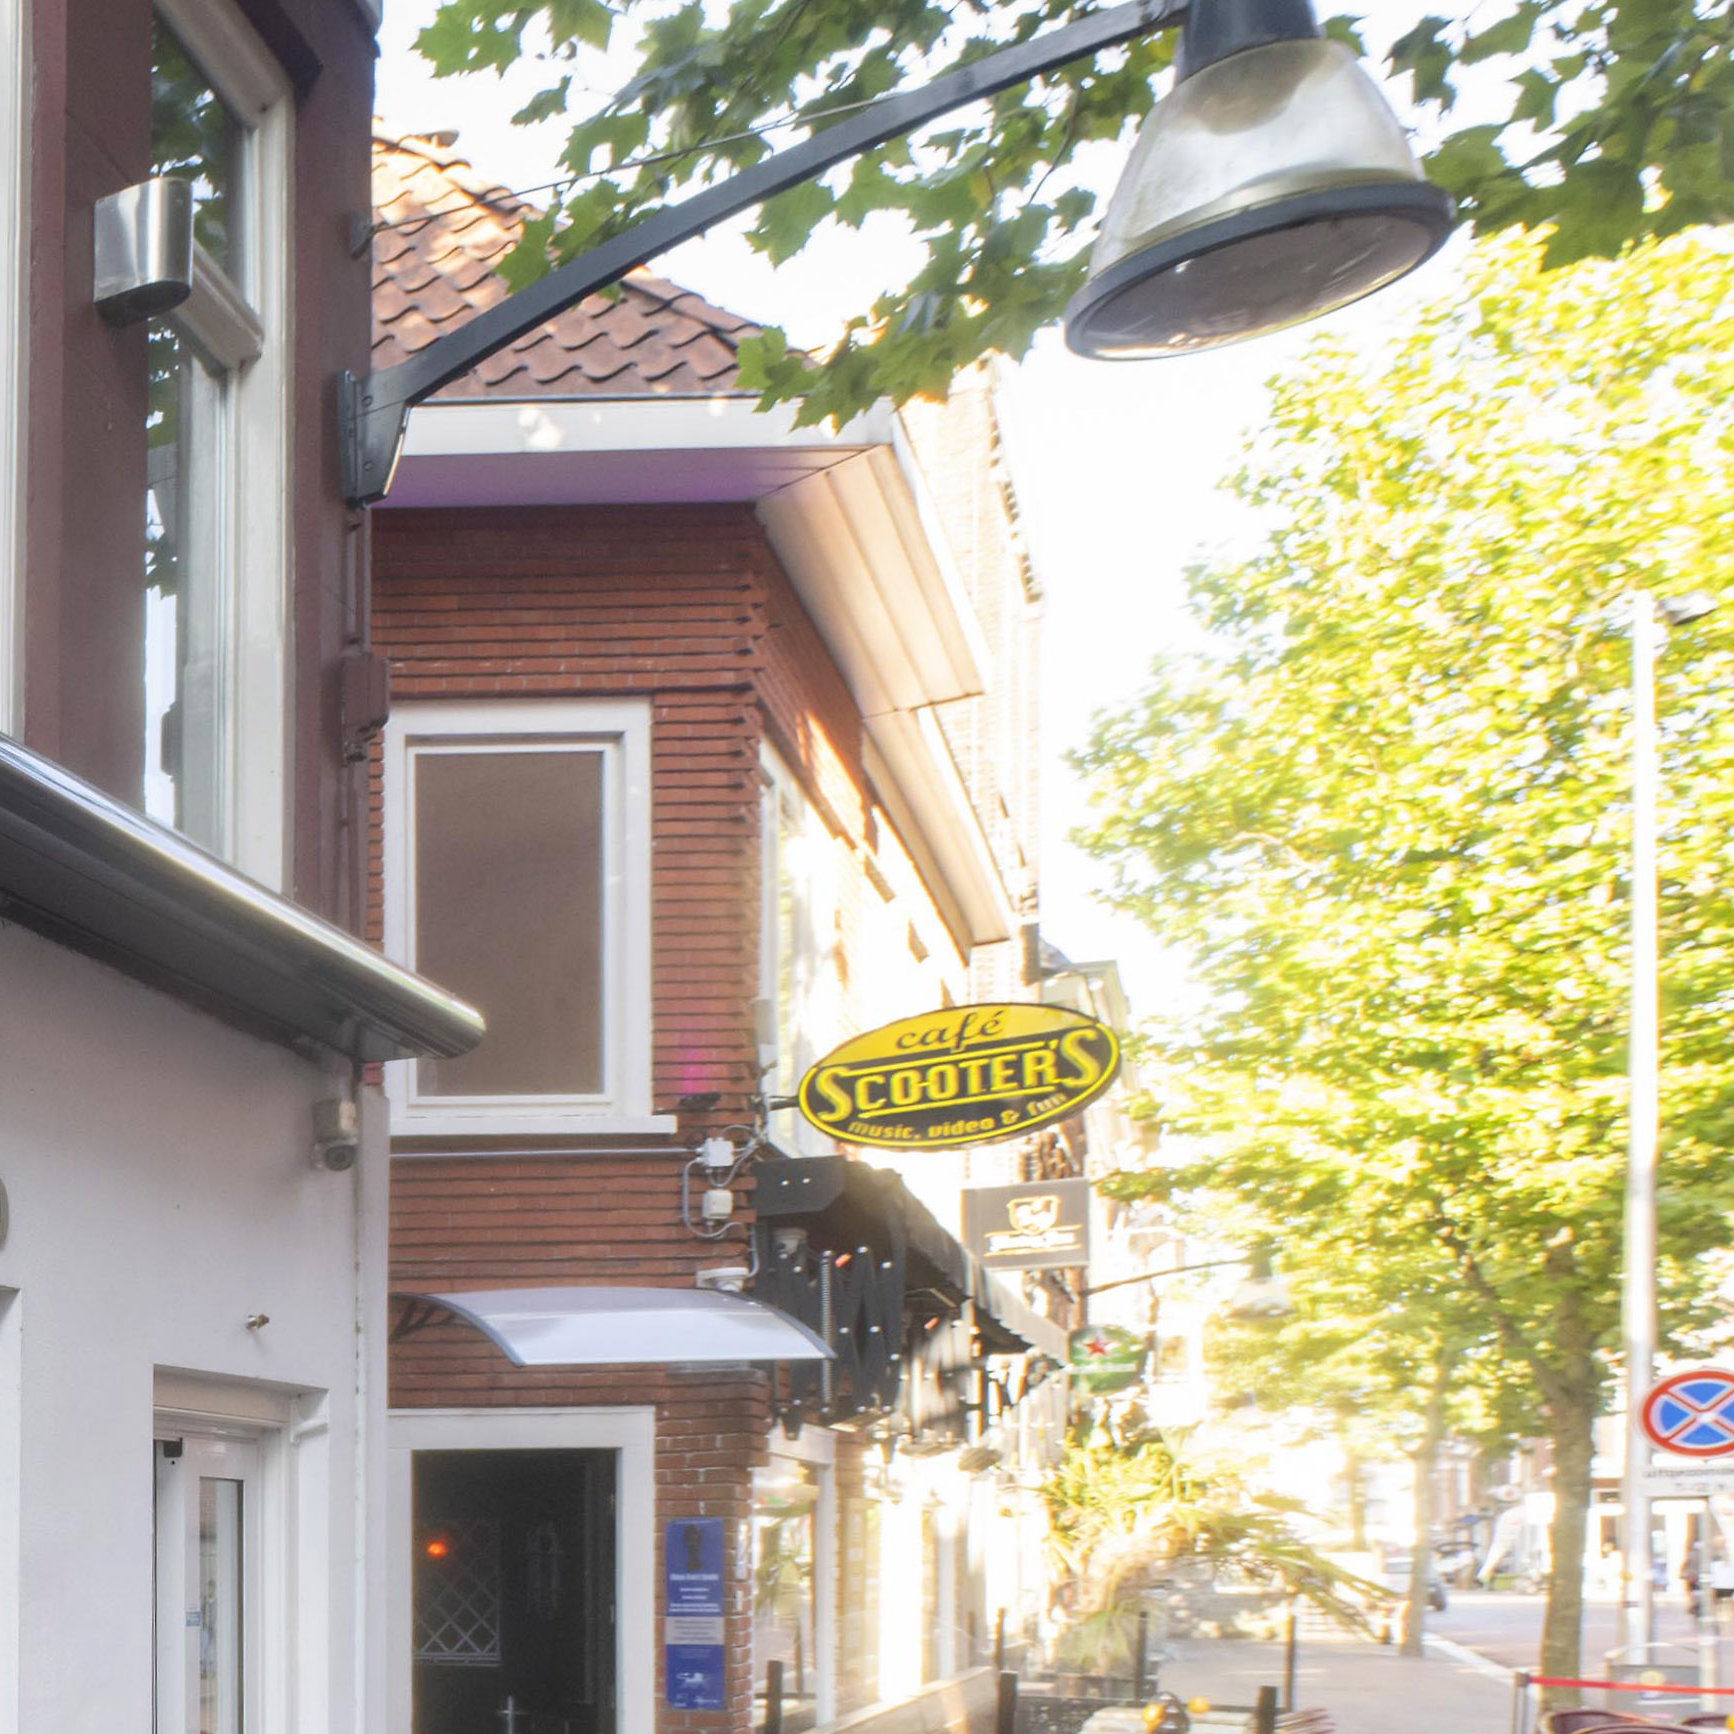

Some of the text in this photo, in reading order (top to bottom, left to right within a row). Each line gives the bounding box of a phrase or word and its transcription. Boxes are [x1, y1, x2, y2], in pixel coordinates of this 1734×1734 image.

[896, 1010, 1006, 1051] café
[928, 1117, 995, 1138] video
[1000, 1109, 1021, 1125] &
[1026, 1092, 1068, 1117] fun
